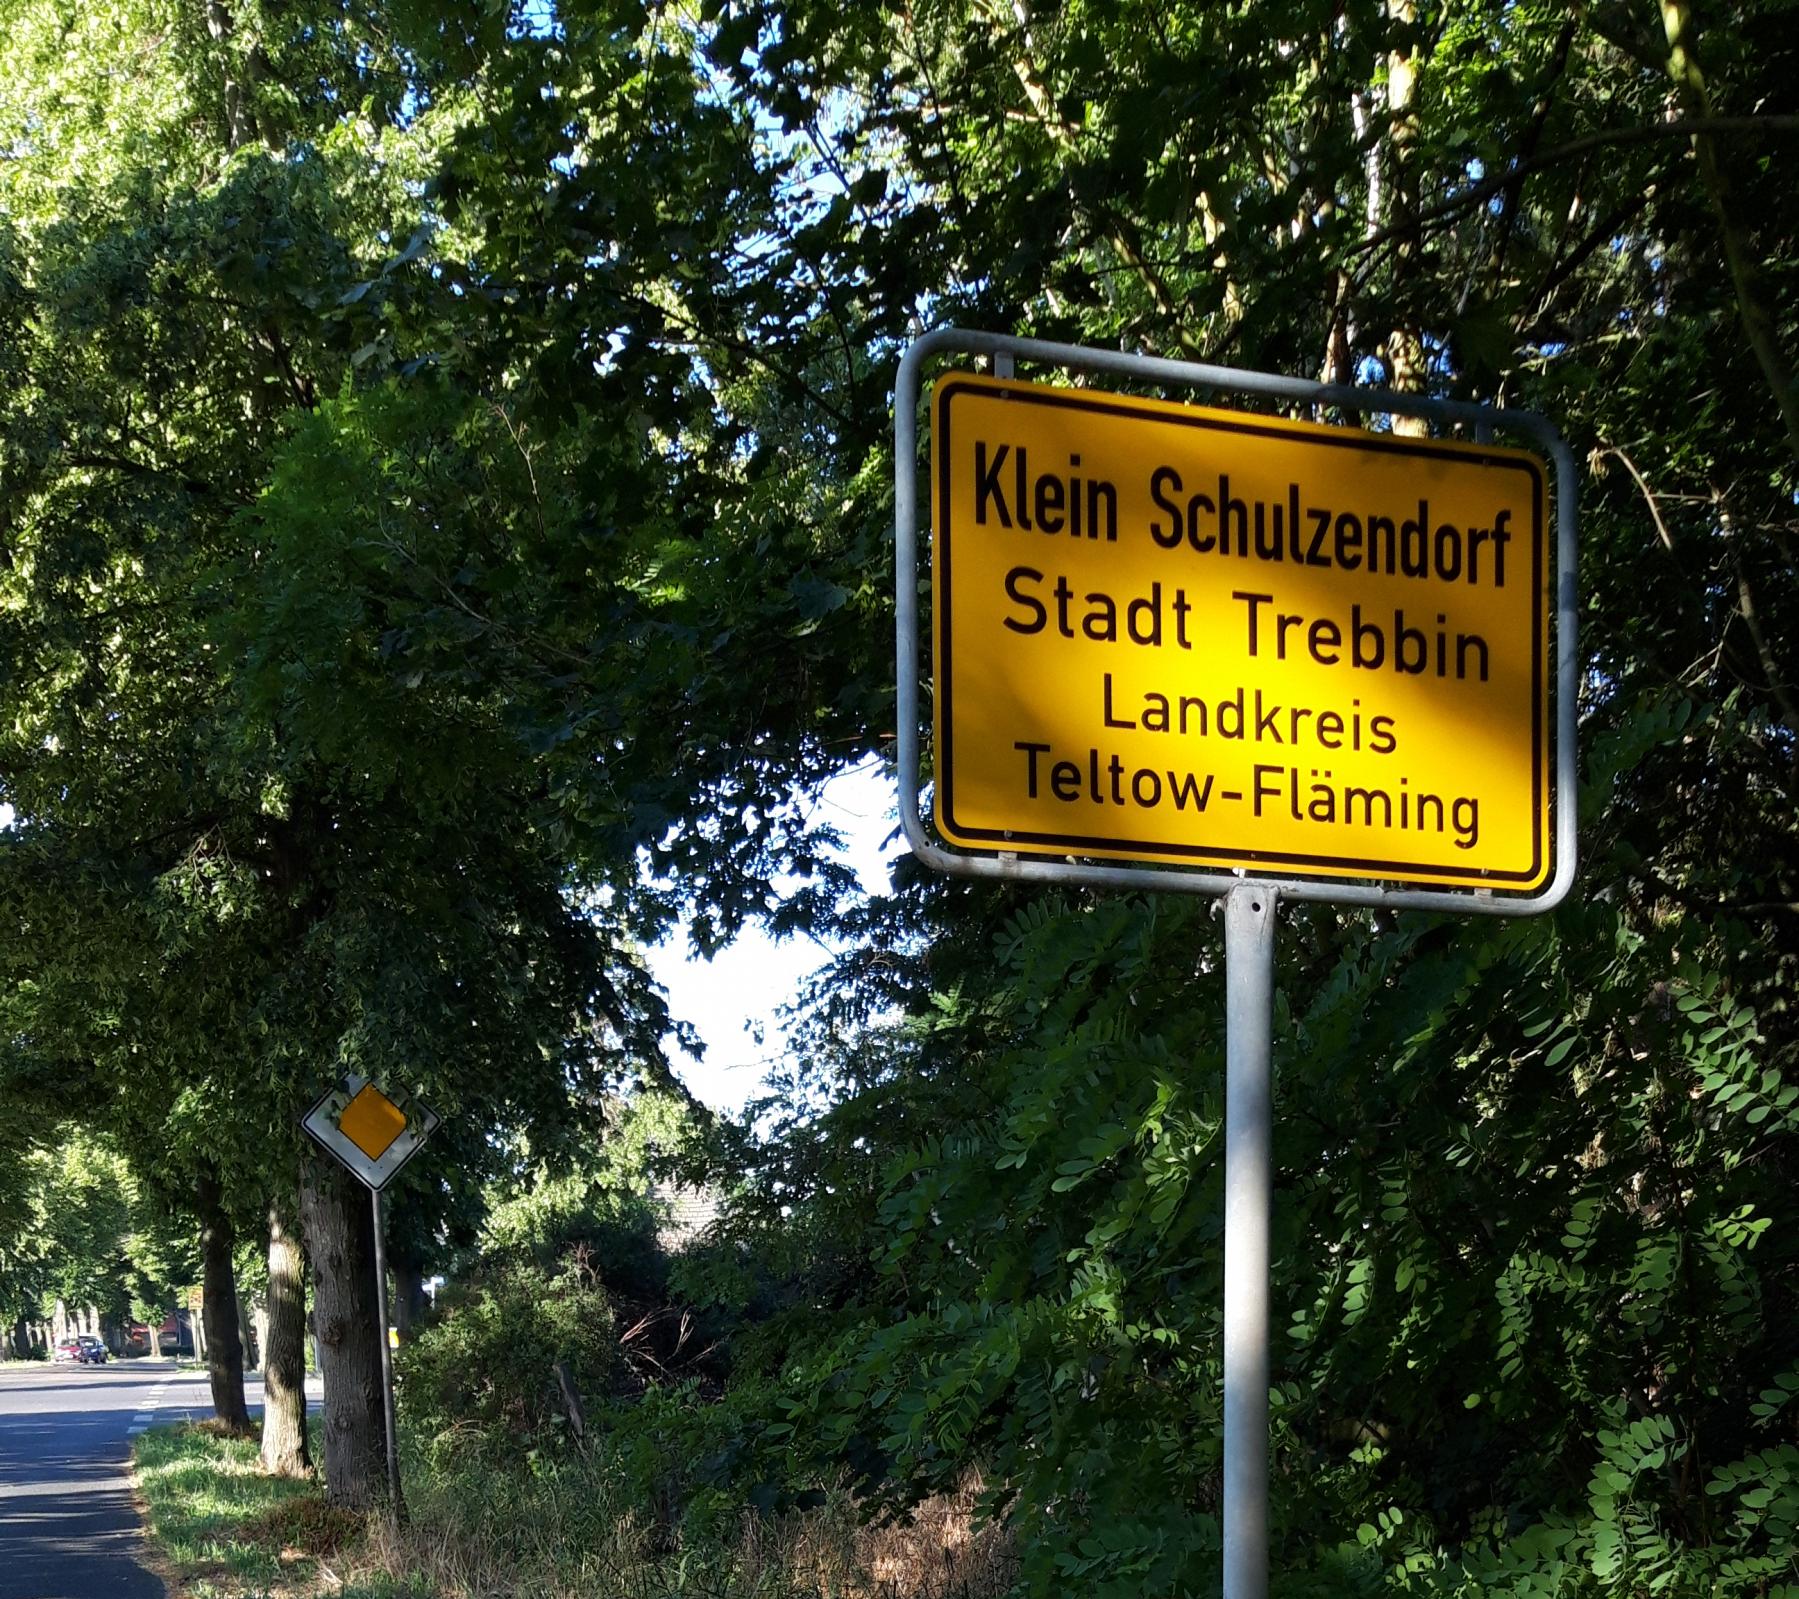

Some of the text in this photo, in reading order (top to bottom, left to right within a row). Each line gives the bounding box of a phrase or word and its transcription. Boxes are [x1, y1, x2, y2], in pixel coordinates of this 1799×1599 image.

[975, 441, 1512, 588] Klein Schulzendorf
[1003, 566, 1489, 682] Stadt Trebbin
[1103, 673, 1397, 754] Landkreis
[1014, 741, 1479, 849] Teltow-Fläming
